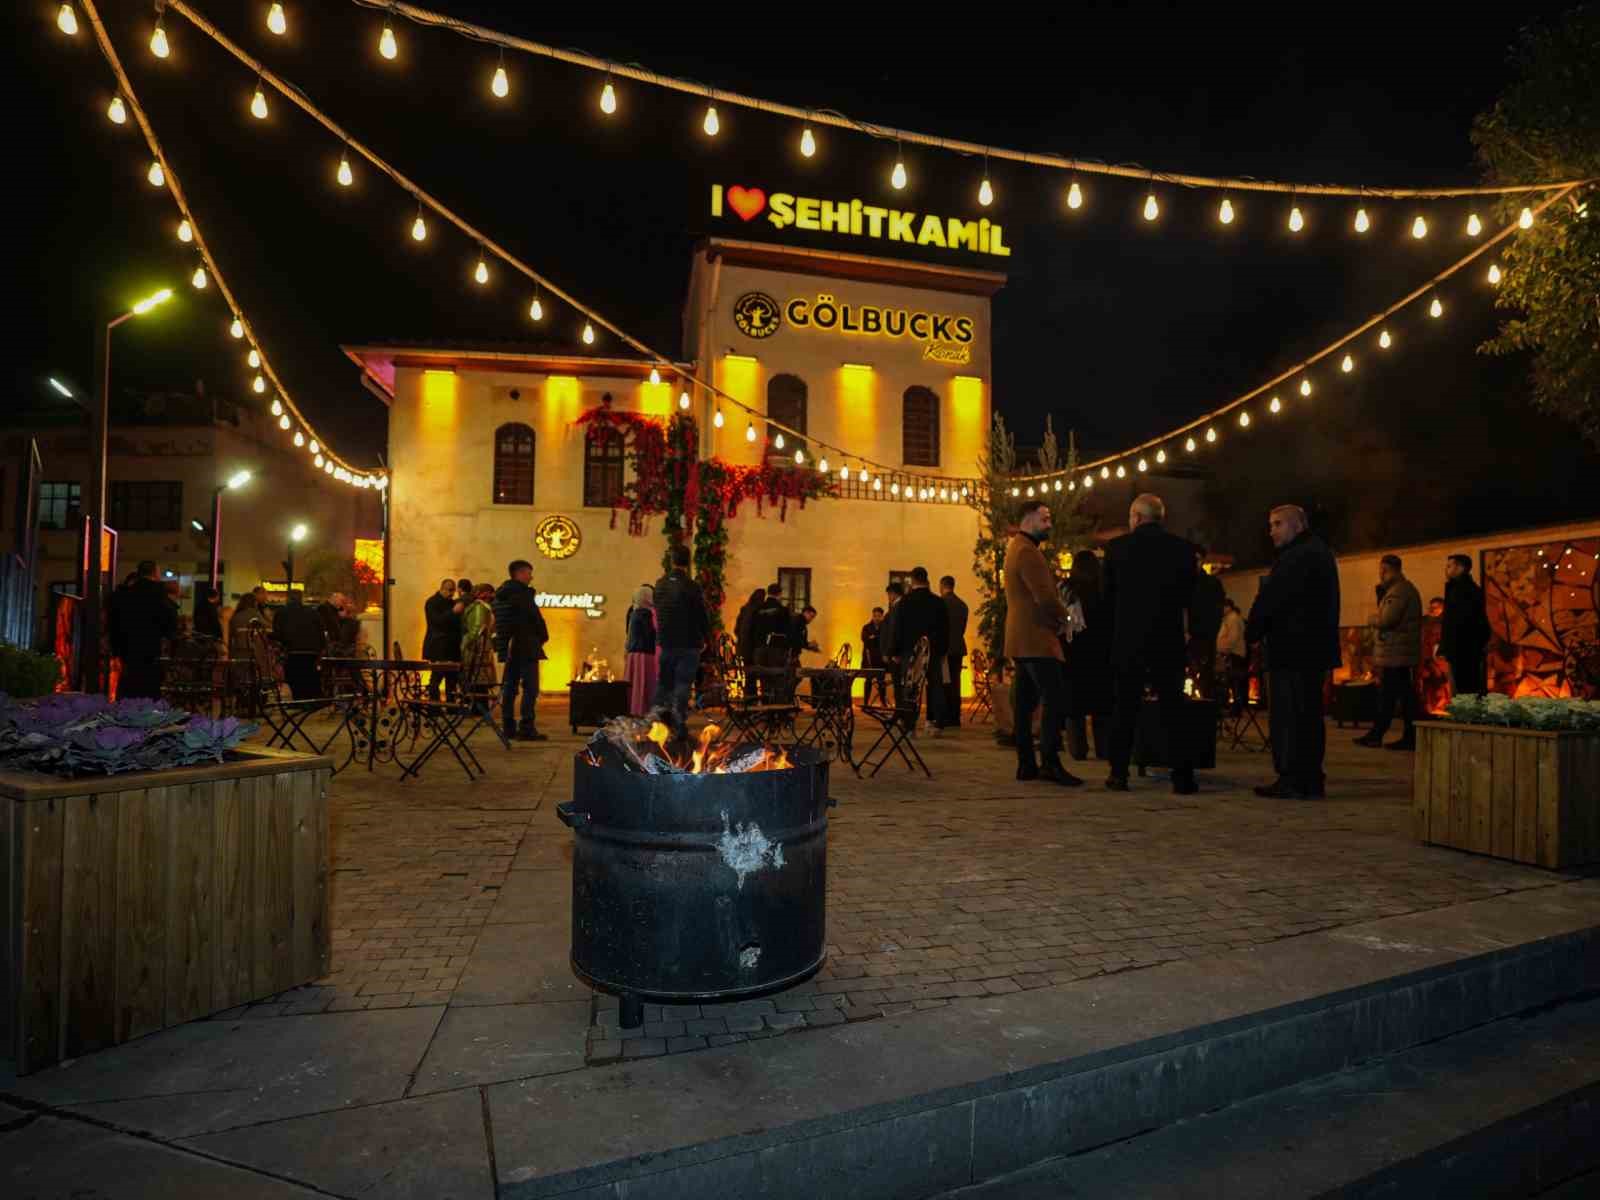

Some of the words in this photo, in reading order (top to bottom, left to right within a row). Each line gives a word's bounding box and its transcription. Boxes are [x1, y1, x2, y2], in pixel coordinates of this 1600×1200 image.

[711, 184, 723, 217] I
[767, 192, 1011, 256] ŞEHİTKAMİL
[787, 294, 974, 343] GÖLBUCKS
